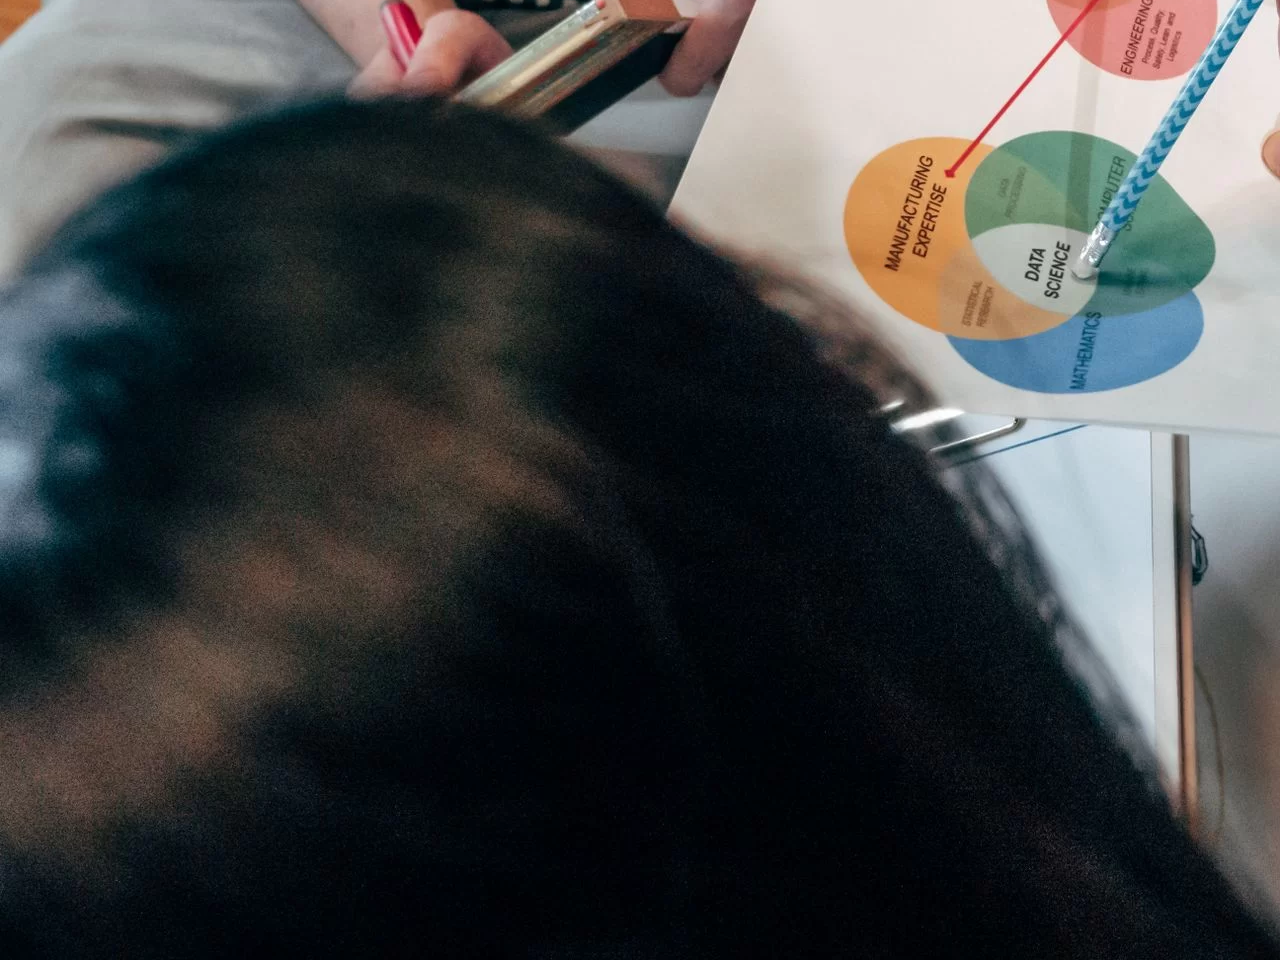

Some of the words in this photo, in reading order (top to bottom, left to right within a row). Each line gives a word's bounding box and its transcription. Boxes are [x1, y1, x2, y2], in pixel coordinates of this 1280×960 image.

[1160, 28, 1171, 46] Lean
[1167, 12, 1176, 26] and
[1167, 31, 1182, 62] Logistics
[884, 155, 933, 272] MANUFACTURING
[911, 183, 948, 259] EXPERTISE
[1024, 247, 1047, 282] DATA
[1044, 241, 1072, 300] SCIENCE
[961, 280, 984, 327] STATISTICAL
[1069, 311, 1102, 391] MATHEMATICS
